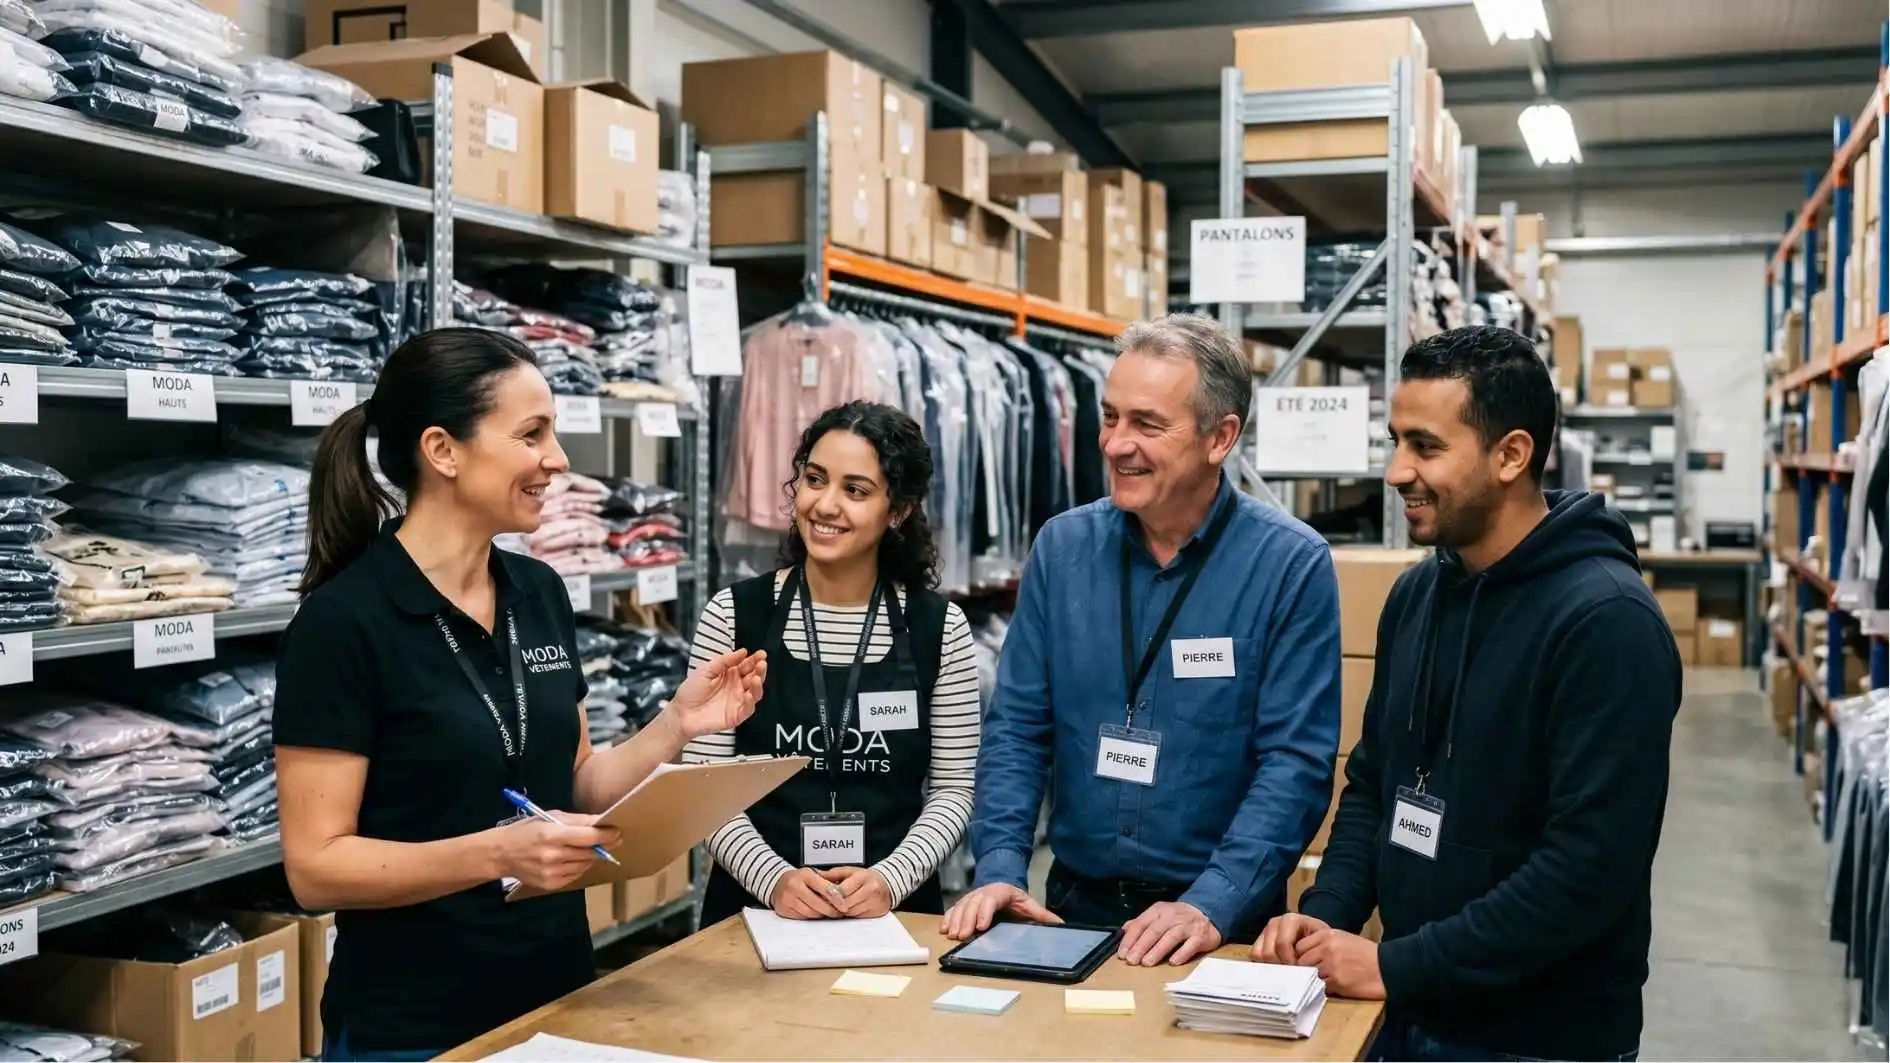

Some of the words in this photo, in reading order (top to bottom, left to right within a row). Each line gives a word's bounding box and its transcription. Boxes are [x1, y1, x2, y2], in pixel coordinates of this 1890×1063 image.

[1200, 226, 1295, 241] PANTALONS
[152, 376, 193, 391] MODA
[308, 385, 341, 400] MODA
[158, 398, 188, 409] HAUTS
[1309, 397, 1349, 412] 2024
[154, 620, 194, 638] MODA
[521, 644, 569, 665] MODA
[1182, 652, 1224, 663] PIERRE
[870, 704, 907, 716] SARAH
[1106, 751, 1148, 768] PIERRE
[1398, 817, 1432, 839] AHMED
[812, 839, 854, 850] SARAH
